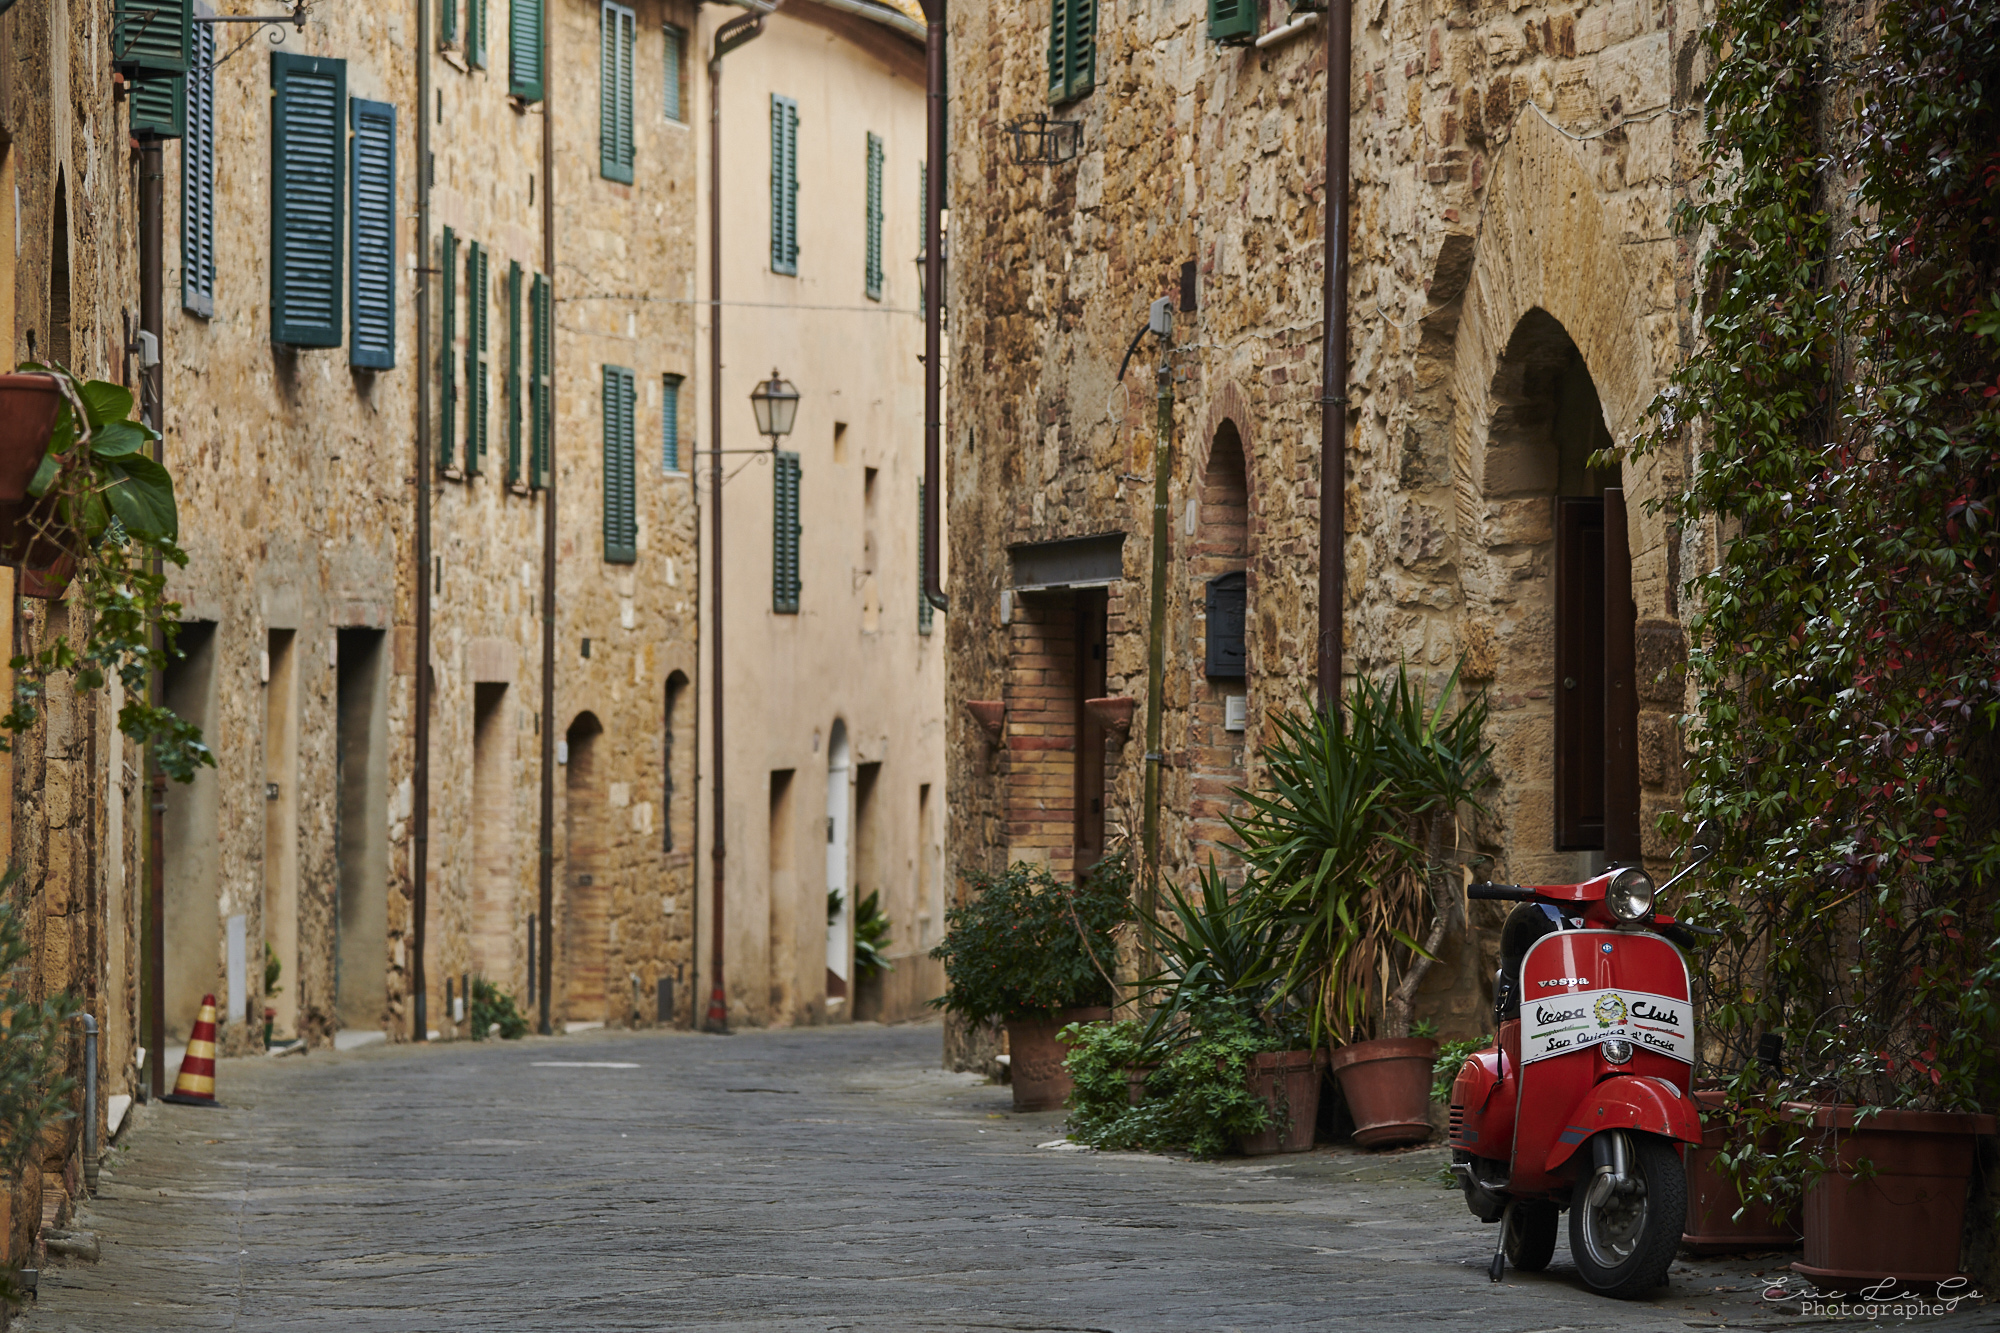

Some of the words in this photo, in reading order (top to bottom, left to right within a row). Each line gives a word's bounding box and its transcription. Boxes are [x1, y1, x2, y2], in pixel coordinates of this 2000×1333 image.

[1537, 977, 1589, 988] vespa
[1536, 1005, 1586, 1027] Vespa
[1630, 1001, 1679, 1026] Club
[1545, 1037, 1572, 1052] San
[1575, 1028, 1626, 1045] Quirico
[1643, 1033, 1675, 1052] Orcia
